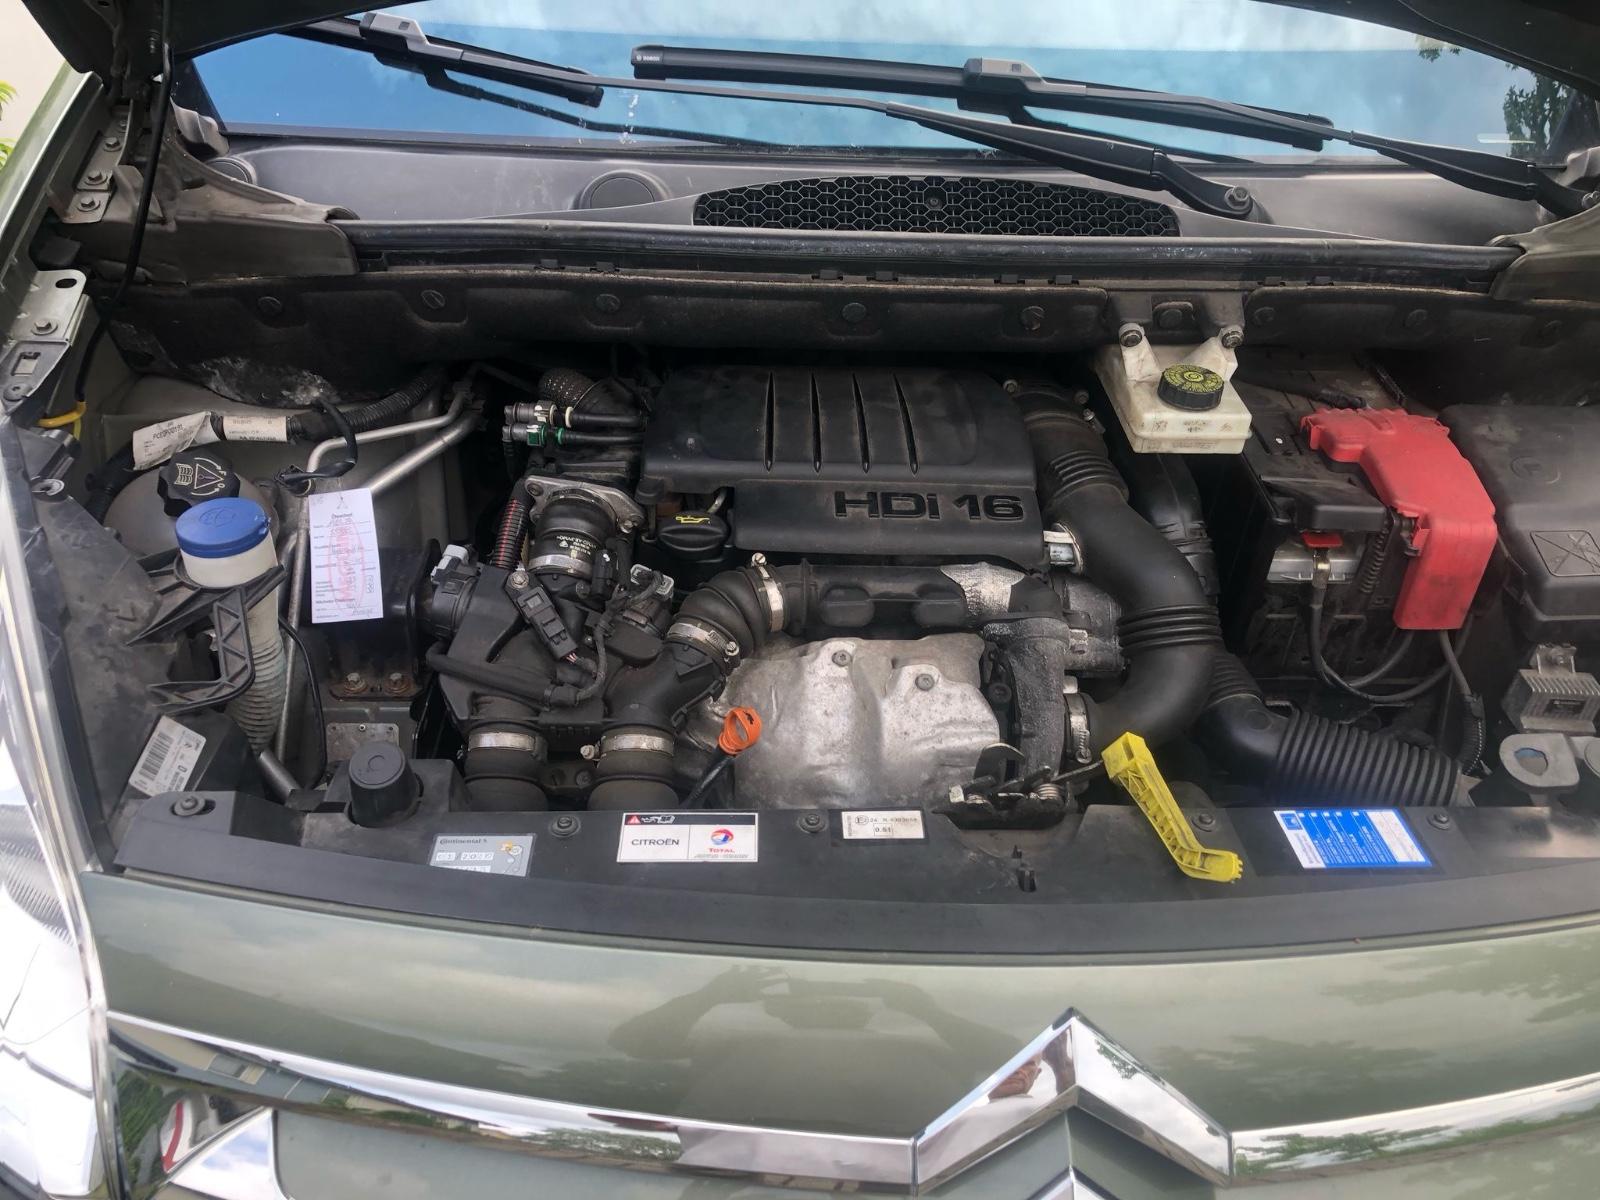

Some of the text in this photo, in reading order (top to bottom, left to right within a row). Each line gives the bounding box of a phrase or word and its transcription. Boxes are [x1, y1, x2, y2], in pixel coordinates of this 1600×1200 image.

[834, 491, 1024, 521] HDi 16
[631, 838, 680, 846] CITROËN
